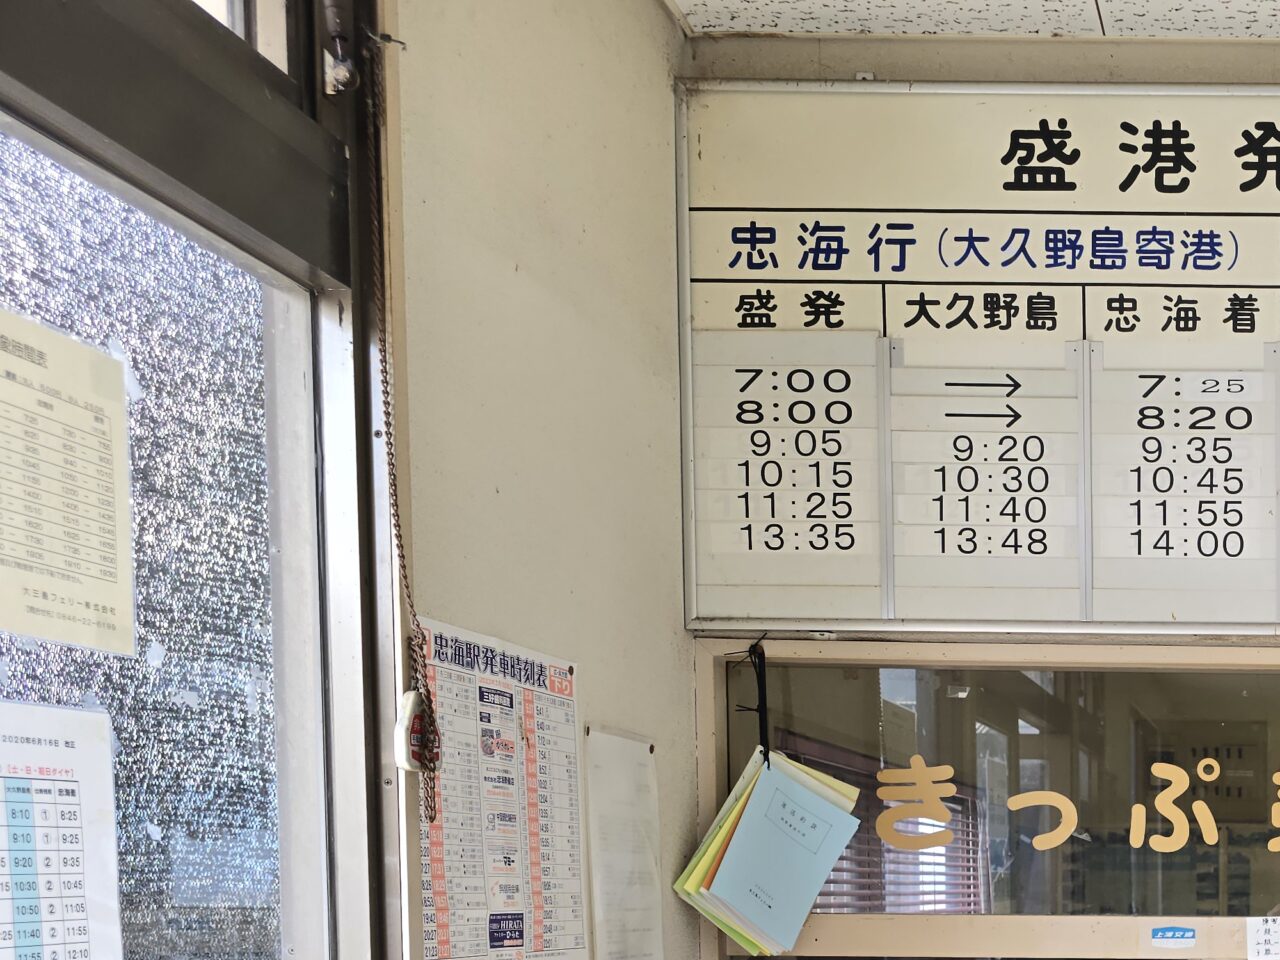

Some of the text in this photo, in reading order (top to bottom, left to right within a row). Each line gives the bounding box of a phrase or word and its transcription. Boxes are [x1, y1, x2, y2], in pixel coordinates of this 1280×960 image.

[735, 289, 845, 328] 盛発
[904, 292, 1057, 331] 大久野島
[1105, 293, 1259, 333] 忠海着
[735, 369, 851, 393] 7:00
[736, 401, 852, 424] 8:00
[1137, 406, 1252, 429] 8:20
[751, 430, 841, 456] 9:05
[953, 435, 1044, 461] 9:20
[1142, 437, 1232, 463] 9:35
[738, 460, 852, 488] 10:15
[935, 466, 1048, 492] 10:30
[1130, 467, 1243, 494] 10:45
[738, 492, 852, 518] 11:25
[933, 496, 1046, 523] 11:40
[1130, 500, 1242, 526] 11:55
[741, 524, 854, 550] 13:35
[934, 528, 1047, 554] 13:48
[1131, 530, 1243, 557] 14:00
[433, 633, 549, 690] 忠海駅発車時刻表
